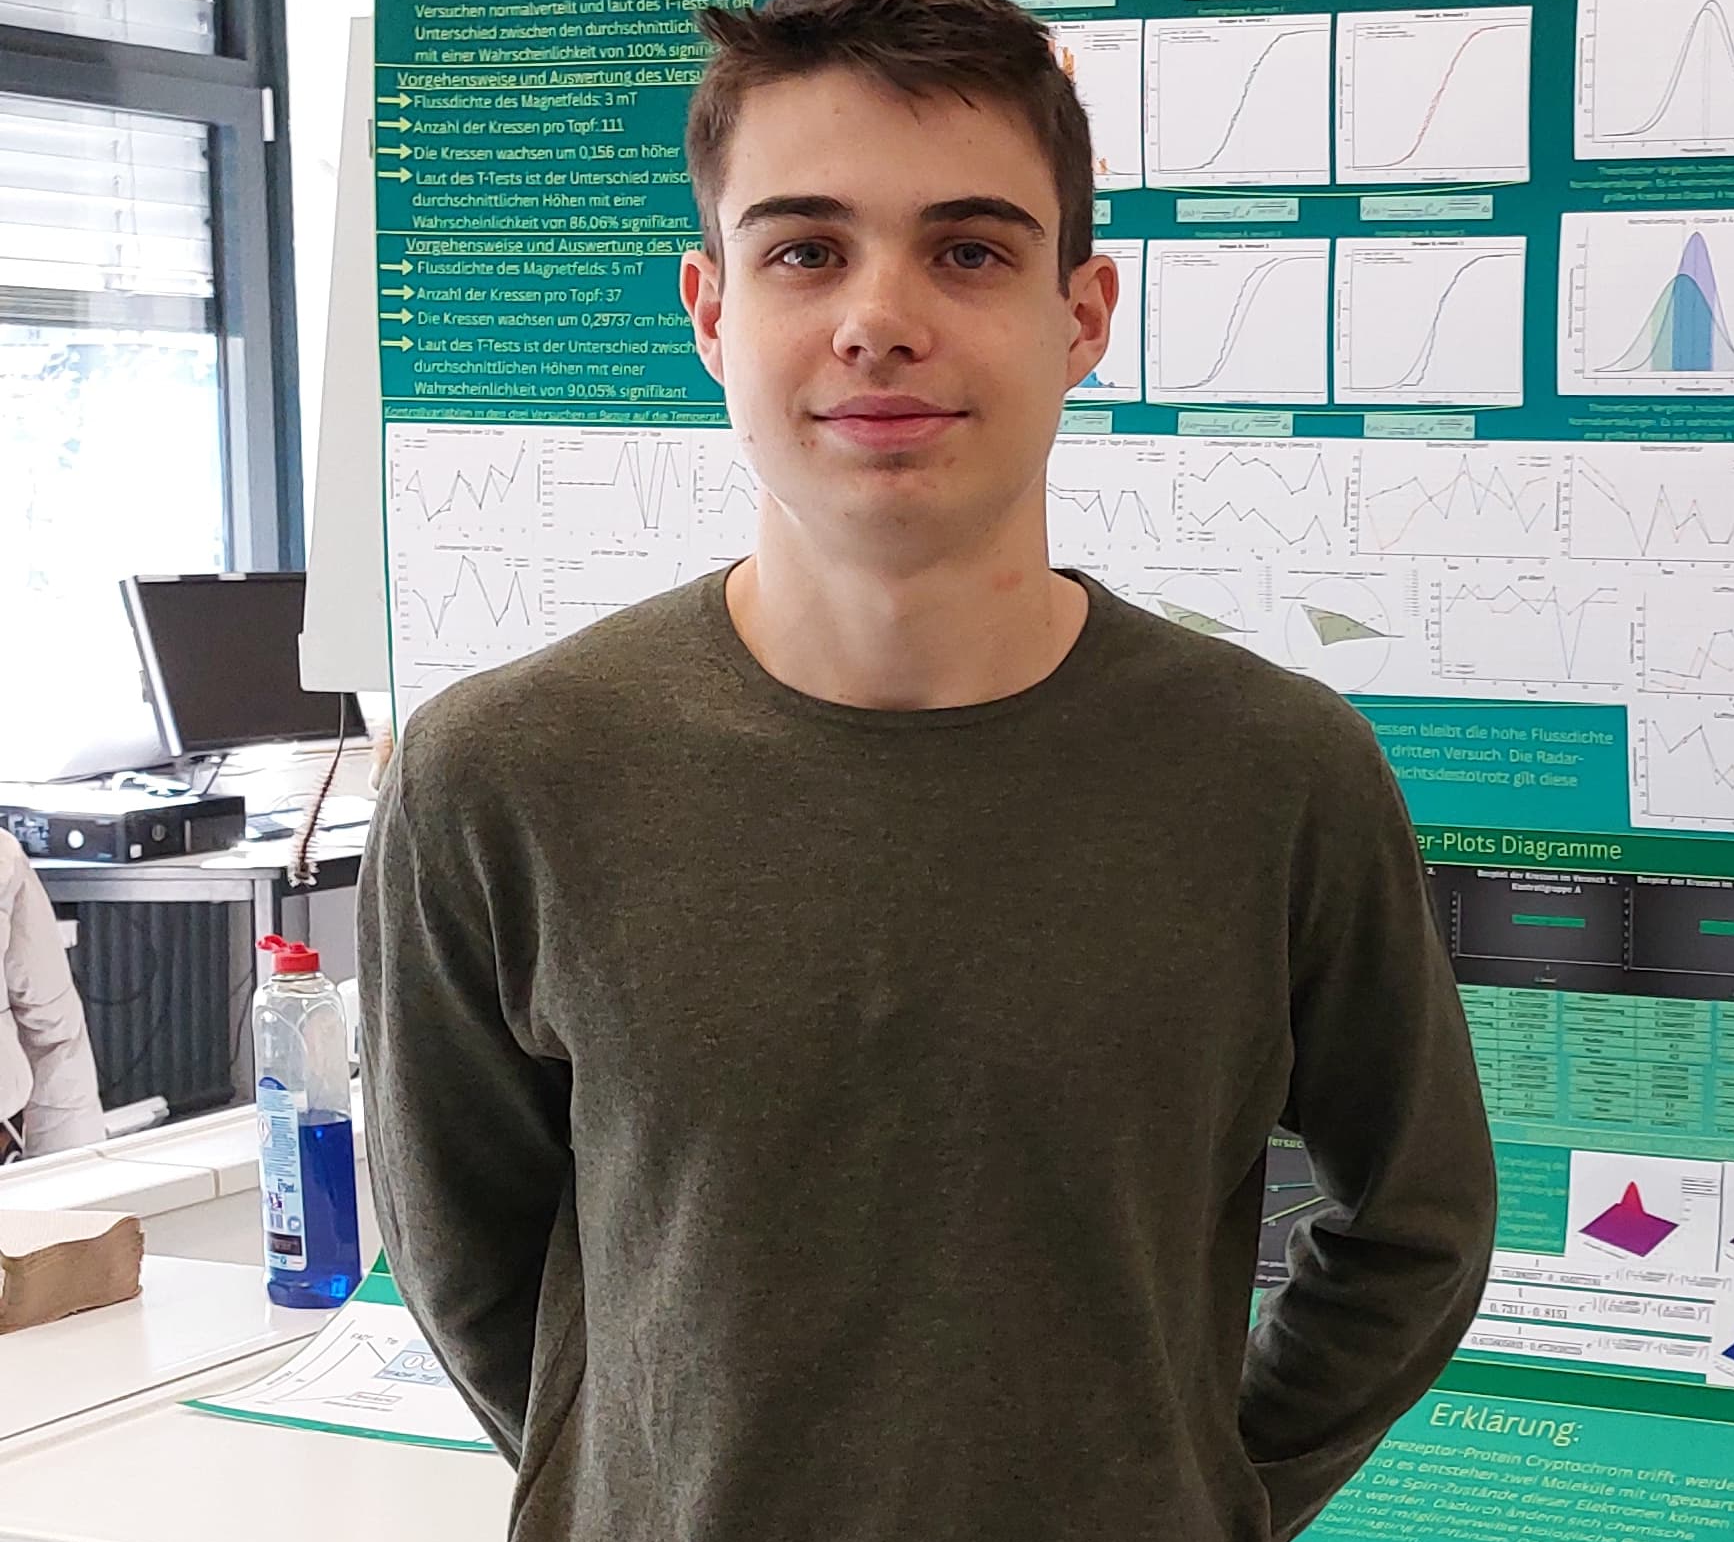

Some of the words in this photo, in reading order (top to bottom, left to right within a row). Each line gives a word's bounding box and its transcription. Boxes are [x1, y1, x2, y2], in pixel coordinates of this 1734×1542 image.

[413, 95, 492, 110] Flussdichte
[496, 95, 518, 108] des
[605, 92, 613, 106] 3
[617, 92, 637, 106] mT
[413, 120, 459, 134] Anzahl
[463, 119, 486, 133] der
[489, 119, 539, 133] Kressen
[543, 122, 564, 137] pro
[601, 118, 623, 132] 111
[413, 147, 437, 160] Die
[441, 147, 493, 160] Kressen
[497, 145, 552, 160] wachsen
[556, 149, 576, 159] um
[618, 147, 638, 159] cm
[642, 143, 679, 159] höher
[416, 171, 446, 186] Laut
[450, 171, 474, 185] des
[477, 170, 522, 185] T-Tests
[526, 170, 541, 185] ist
[545, 170, 566, 185] der
[569, 170, 649, 185] Unterschied
[413, 192, 539, 208] durchschnittlichen
[542, 192, 586, 207] Höhen
[589, 192, 610, 207] mit
[614, 192, 646, 207] einer
[413, 215, 538, 230] Wahrscheinlichkeit
[541, 218, 567, 230] von
[417, 261, 494, 276] Flussdichte
[497, 261, 520, 276] des
[611, 261, 620, 275] 5
[623, 261, 643, 276] mT
[417, 288, 461, 302] Anzahl
[464, 288, 487, 302] der
[490, 288, 541, 302] Kressen
[544, 291, 566, 305] pro
[605, 288, 622, 302] 37
[418, 311, 440, 326] Die
[443, 312, 495, 326] Kressen
[498, 312, 554, 326] wachsen
[558, 315, 578, 326] um
[635, 315, 654, 326] cm
[658, 312, 691, 327] höhe
[1420, 723, 1462, 738] bleibt
[1466, 724, 1487, 739] die
[1491, 726, 1527, 740] hohe
[1532, 728, 1614, 745] Flussdichte
[1392, 744, 1440, 758] dritten
[1509, 749, 1532, 763] Die
[1514, 771, 1536, 787] gilt
[1540, 774, 1578, 787] diese
[1502, 835, 1622, 860] Diagramme
[1430, 1402, 1583, 1447] Erklärung:
[1370, 1458, 1393, 1468] nd
[1418, 1462, 1498, 1481] entstehen
[1526, 1453, 1633, 1477] Cryptochrom
[1373, 1474, 1398, 1487] Die
[1668, 1510, 1729, 1528] können
